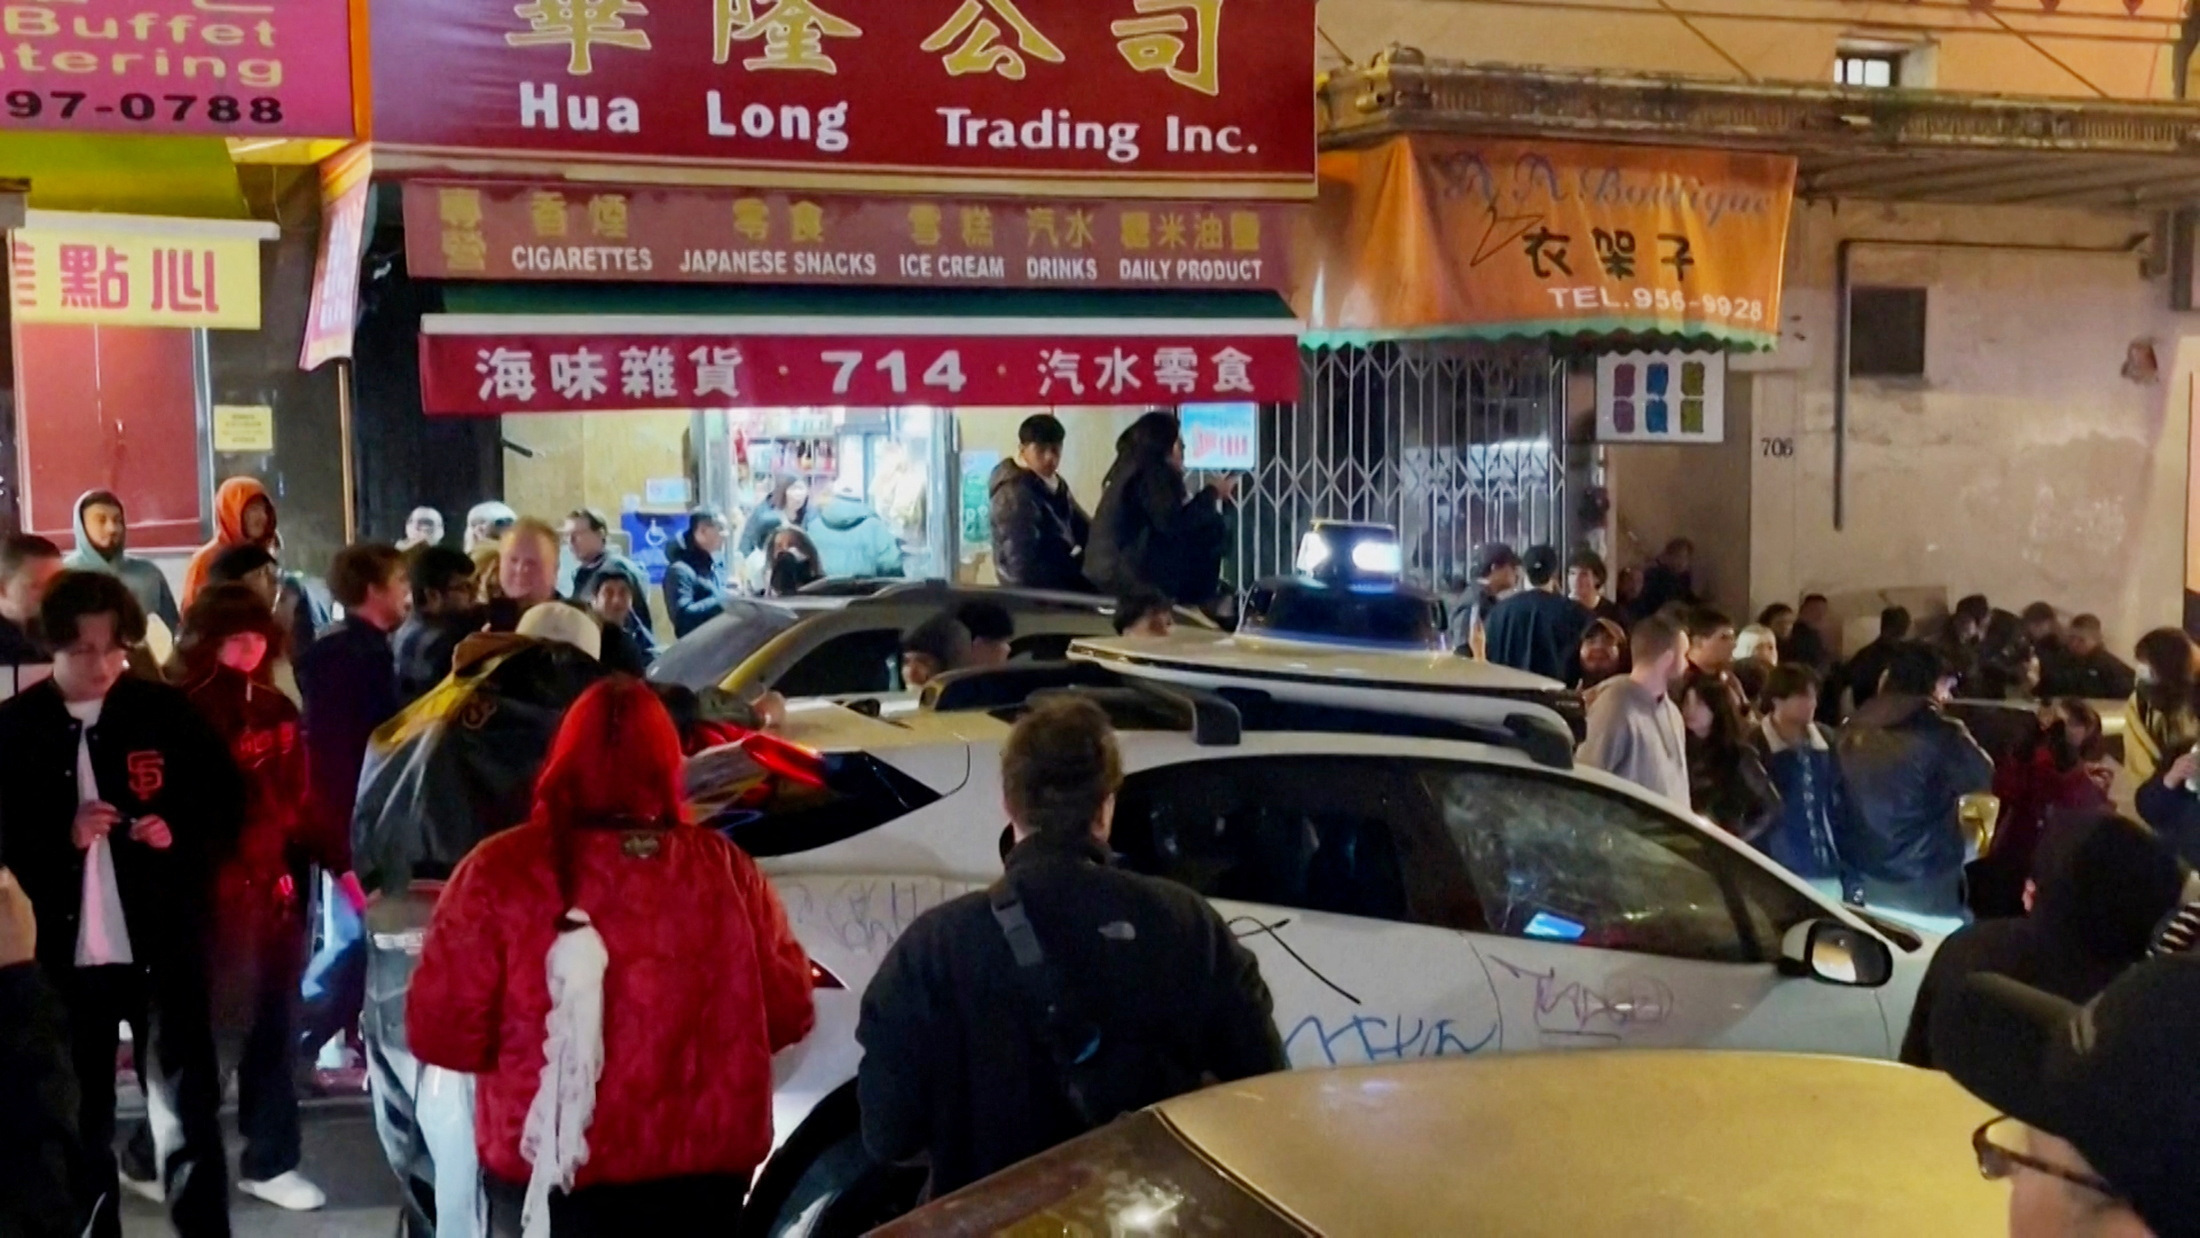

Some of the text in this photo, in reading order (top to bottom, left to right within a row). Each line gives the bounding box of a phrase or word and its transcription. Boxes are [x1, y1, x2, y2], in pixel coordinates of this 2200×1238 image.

[4, 5, 276, 47] Buffet
[0, 42, 283, 88] tering
[5, 89, 283, 125] 97-0788
[519, 81, 1258, 163] Hua Long Trading Inc.
[511, 245, 1263, 283] CIGARETTES JAPANESE SNACKS ICE CREAM DRINKS DAILY PRODUCT
[1521, 226, 1695, 282] 衣架子
[475, 345, 1255, 401] 海味雜貨 714 汽水零食
[1760, 437, 1794, 459] 706
